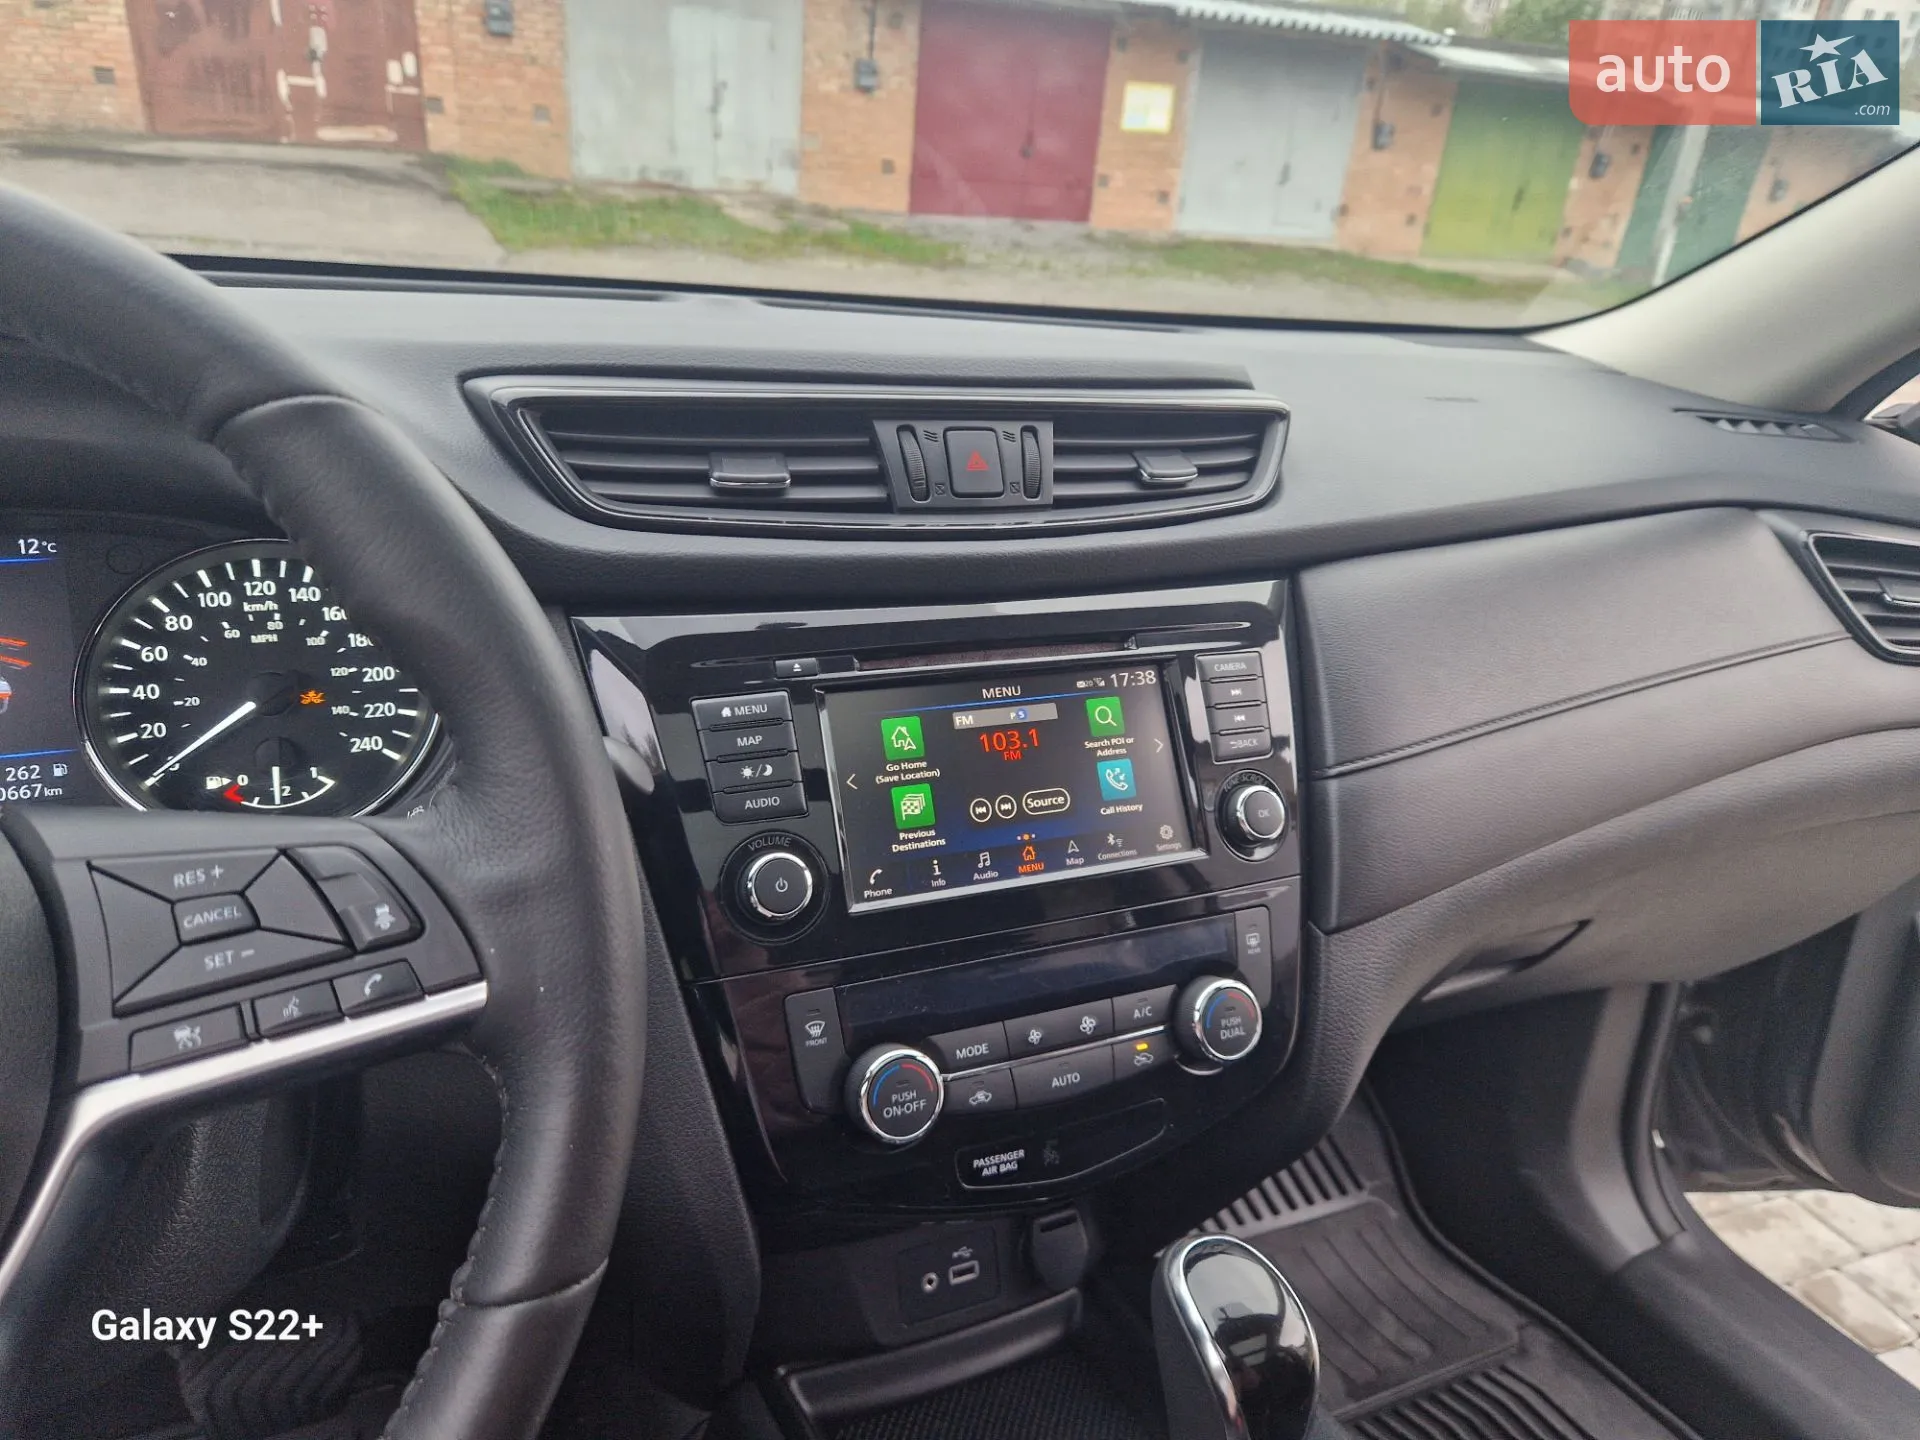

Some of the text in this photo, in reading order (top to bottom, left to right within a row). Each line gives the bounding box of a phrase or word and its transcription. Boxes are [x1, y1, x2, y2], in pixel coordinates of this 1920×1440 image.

[243, 580, 276, 596] 120
[288, 586, 321, 602] 140
[198, 591, 231, 608] 100
[243, 600, 279, 612] km/h
[165, 615, 193, 631] 80
[267, 621, 283, 630] 80
[224, 629, 240, 638] 60
[251, 633, 278, 643] MPH
[305, 636, 326, 646] 100
[141, 645, 168, 662] 60
[191, 657, 208, 666] 40
[1214, 662, 1247, 672] CAMERA
[330, 667, 349, 676] 120
[362, 666, 395, 682] 200
[1110, 669, 1156, 687] 17:38
[132, 683, 160, 700] 40
[982, 686, 1021, 699] MENU
[184, 697, 200, 706] 20
[331, 705, 350, 715] 140
[363, 702, 396, 718] 220
[734, 704, 768, 717] MENU
[955, 715, 974, 726] FM
[140, 722, 167, 739] 20
[350, 736, 383, 753] 240
[737, 734, 763, 747] MAP
[980, 728, 1039, 752] 103.1
[1084, 739, 1109, 750] Search
[1126, 737, 1134, 745] or
[1237, 738, 1259, 748] BACK
[1003, 750, 1022, 760] FM
[1096, 746, 1127, 757] Address
[886, 760, 927, 772] Go Home
[5, 765, 41, 781] 262
[875, 768, 941, 785] (Save Location)
[44, 786, 62, 796] km
[744, 796, 780, 810] AUDIO
[1027, 794, 1065, 808] Source
[1100, 802, 1143, 816] Call History
[899, 828, 936, 841] Previous
[747, 836, 792, 851] VOLUME
[892, 837, 946, 853] Destinations
[1156, 841, 1182, 852] Settings
[1097, 848, 1137, 860] Connections
[1066, 855, 1085, 867] Map
[1018, 863, 1045, 873] MENU
[173, 871, 206, 889] RES
[973, 869, 998, 881] Audio
[931, 877, 946, 887] Info
[863, 887, 893, 900] Phone
[183, 906, 242, 929] CANCEL
[204, 951, 235, 970] SET
[1133, 1006, 1153, 1020] A/C
[1221, 1015, 1242, 1027] PUSH
[1220, 1026, 1246, 1040] DUAL
[805, 1037, 828, 1047] FRONT
[956, 1044, 989, 1060] MODE
[1051, 1072, 1081, 1088] AUTO
[891, 1090, 917, 1103] PUSH
[973, 1149, 1025, 1169] PASSENGER
[982, 1160, 1018, 1177] AIR BAG
